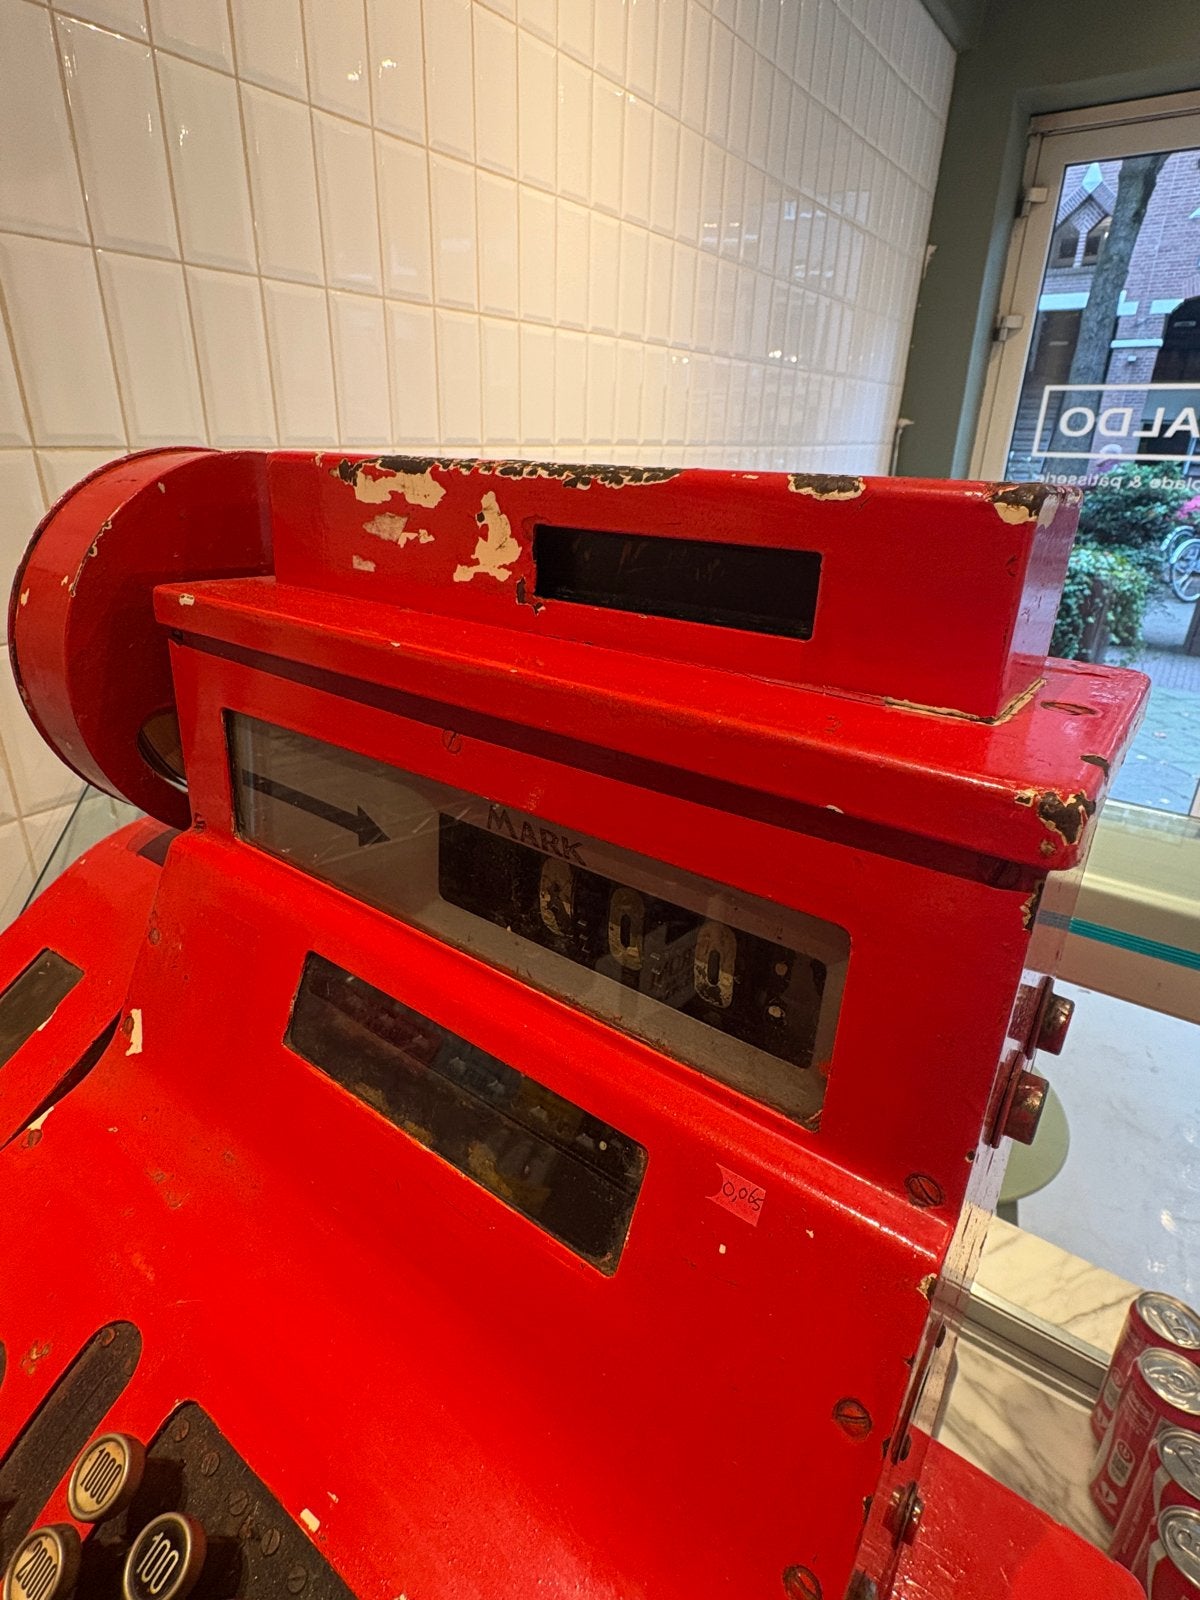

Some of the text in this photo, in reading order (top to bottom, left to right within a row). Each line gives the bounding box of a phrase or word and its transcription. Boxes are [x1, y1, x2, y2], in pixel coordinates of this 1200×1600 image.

[487, 804, 587, 867] MARK
[79, 1447, 123, 1506] 1000
[15, 1539, 57, 1600] 2000
[136, 1531, 180, 1595] 100
